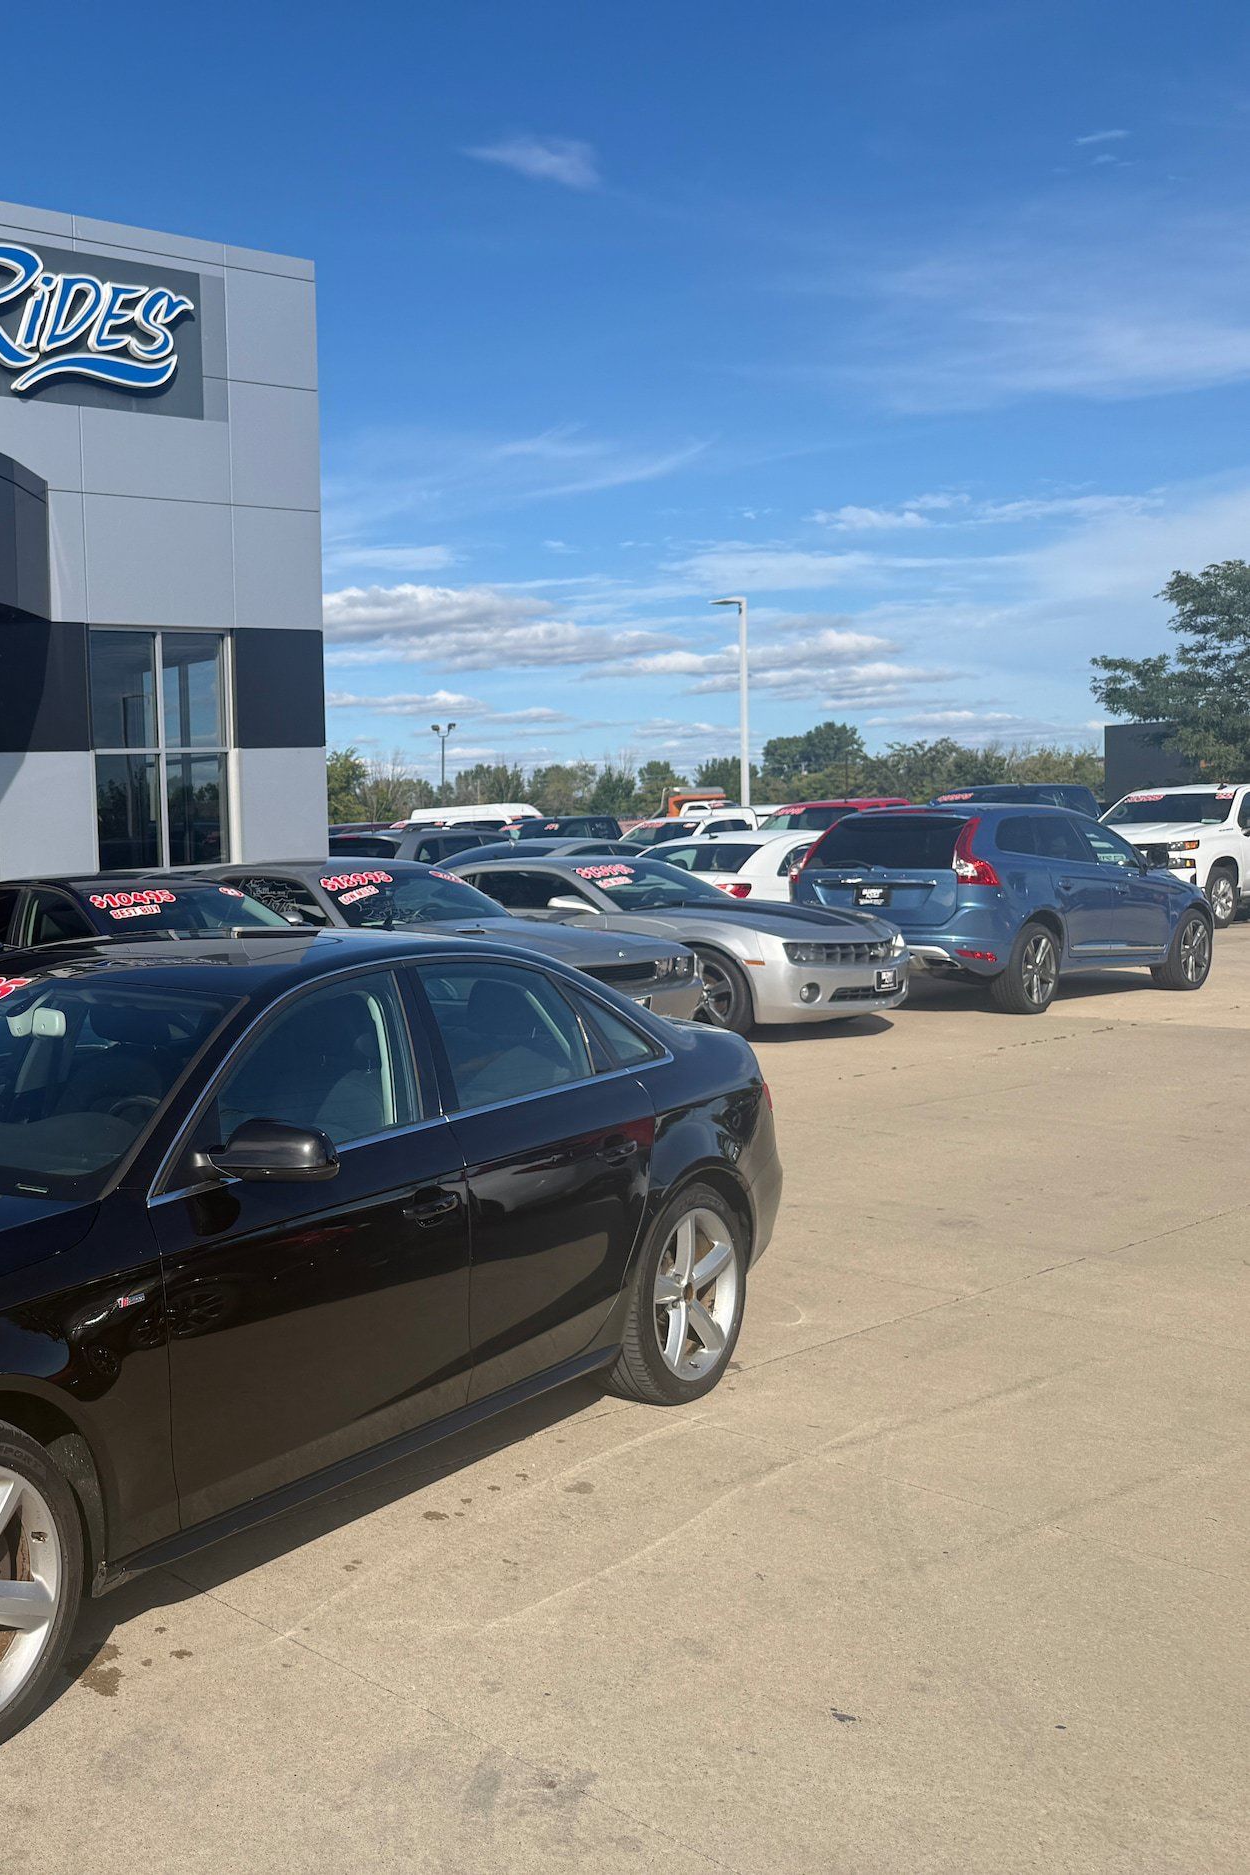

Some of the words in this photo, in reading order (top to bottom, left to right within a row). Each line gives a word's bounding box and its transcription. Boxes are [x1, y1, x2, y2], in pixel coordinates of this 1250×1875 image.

[90, 889, 176, 909] $10495
[110, 908, 137, 919] BEST
[140, 905, 161, 916] BUY
